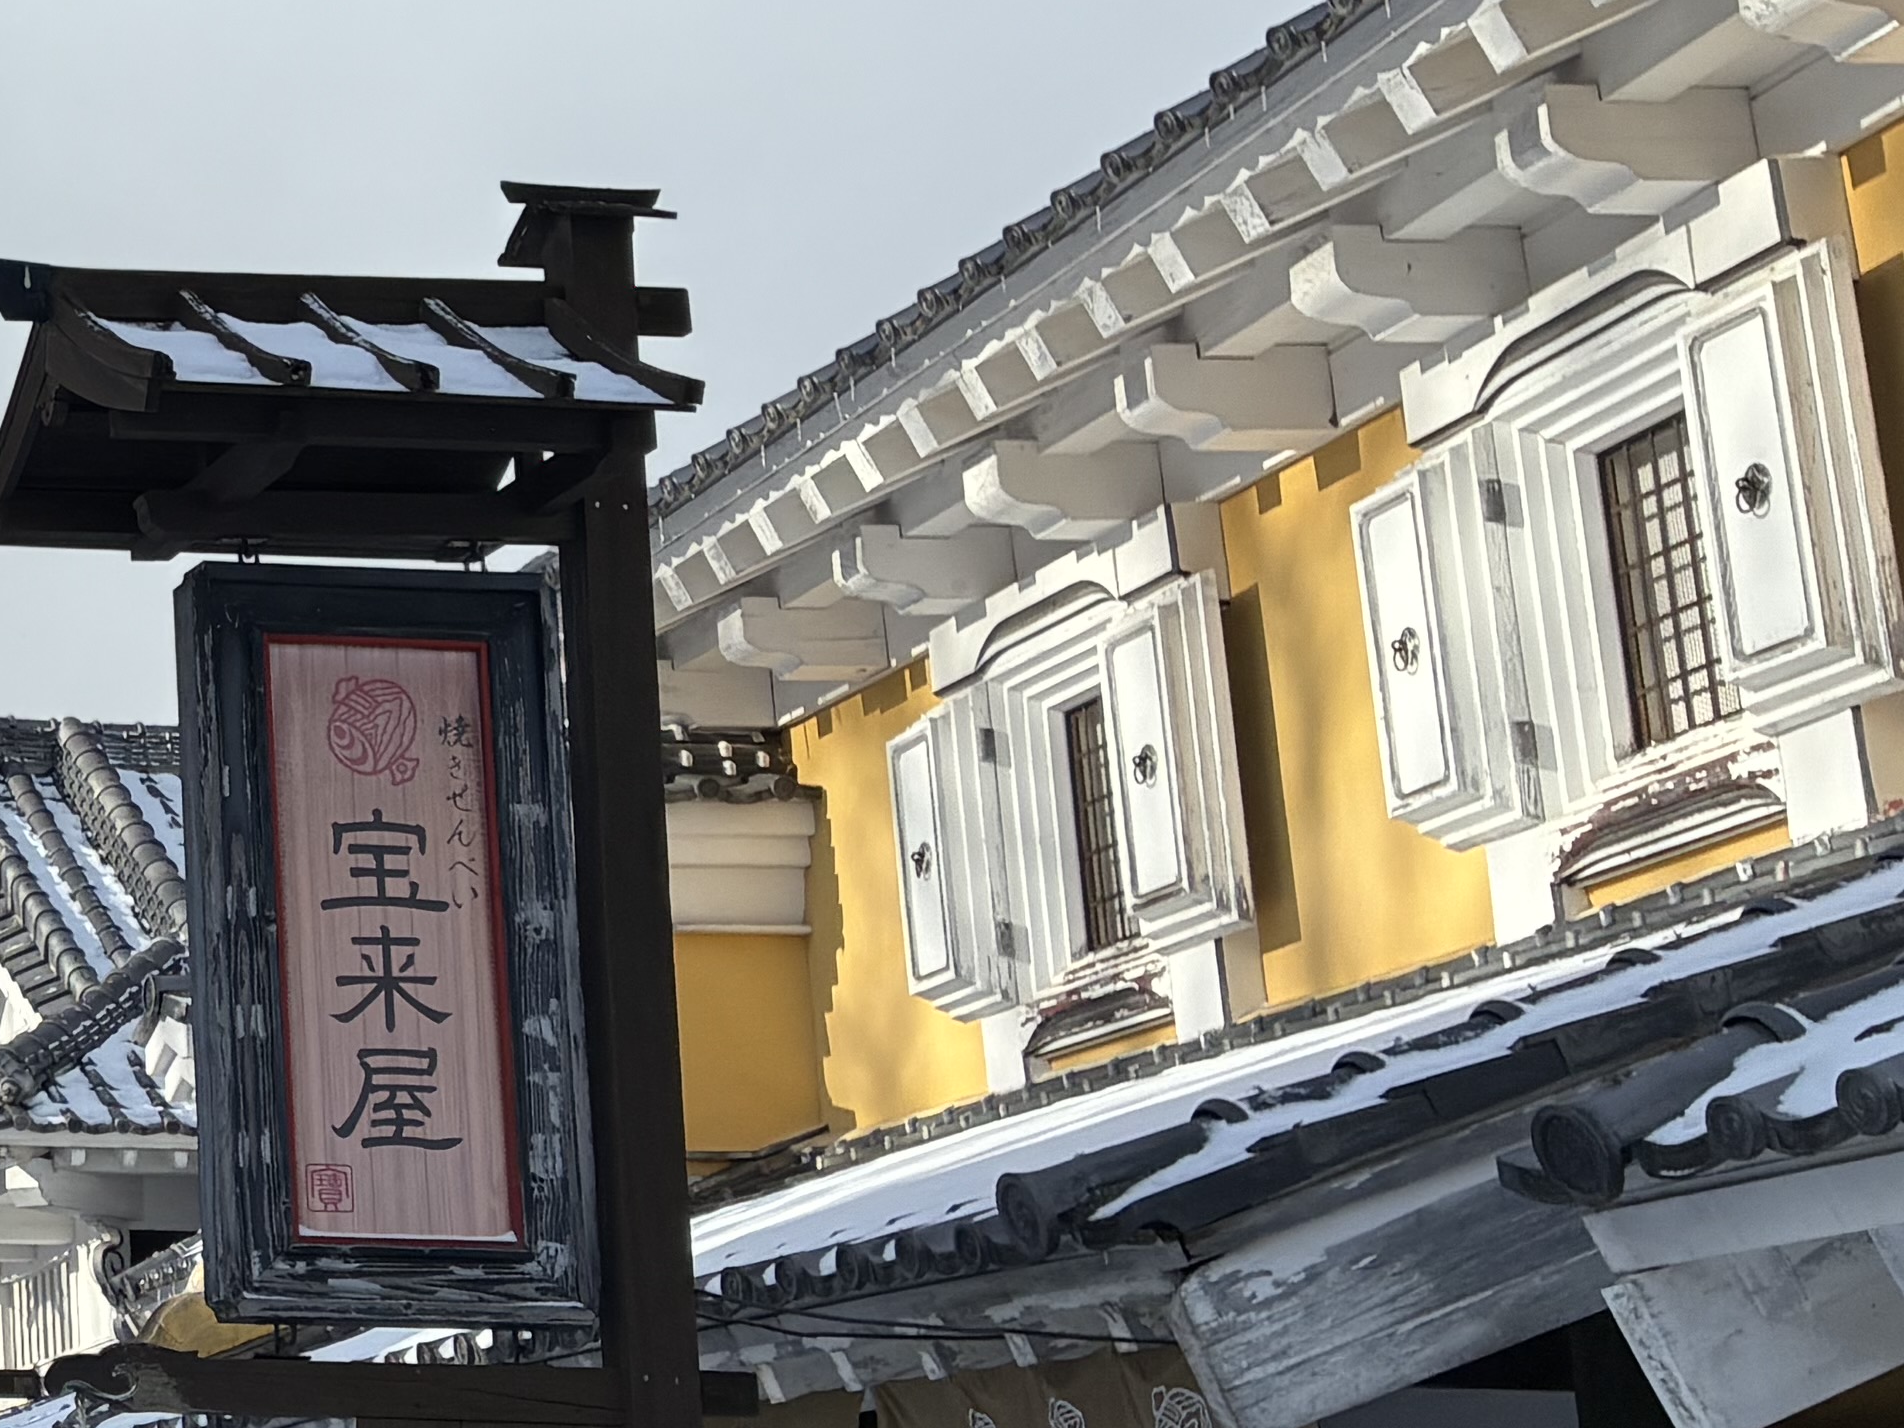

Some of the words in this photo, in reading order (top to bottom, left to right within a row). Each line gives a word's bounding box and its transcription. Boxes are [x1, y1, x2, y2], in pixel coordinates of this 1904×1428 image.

[437, 714, 480, 910] 焼きせんべい
[319, 808, 464, 1152] 宝来屋
